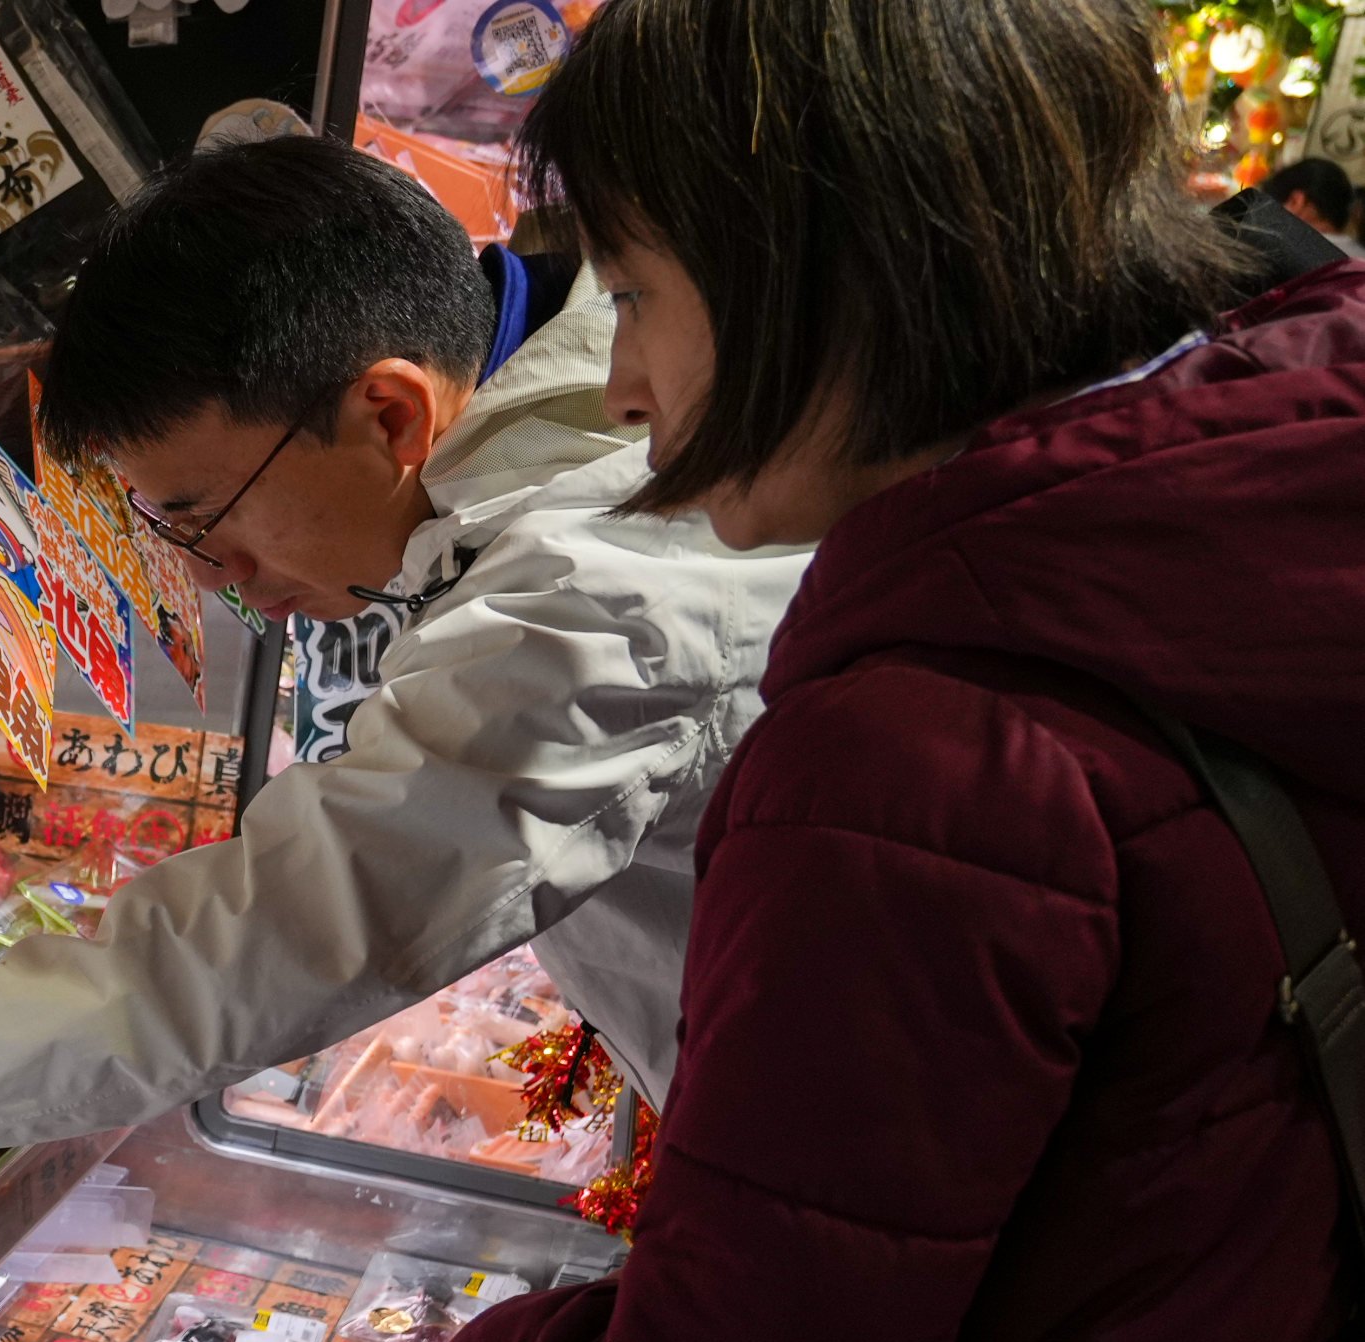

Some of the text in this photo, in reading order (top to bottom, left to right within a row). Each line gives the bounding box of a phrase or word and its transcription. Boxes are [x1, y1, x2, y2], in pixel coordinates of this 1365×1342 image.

[36, 554, 128, 722] 池魚
[57, 728, 192, 784] あわび
